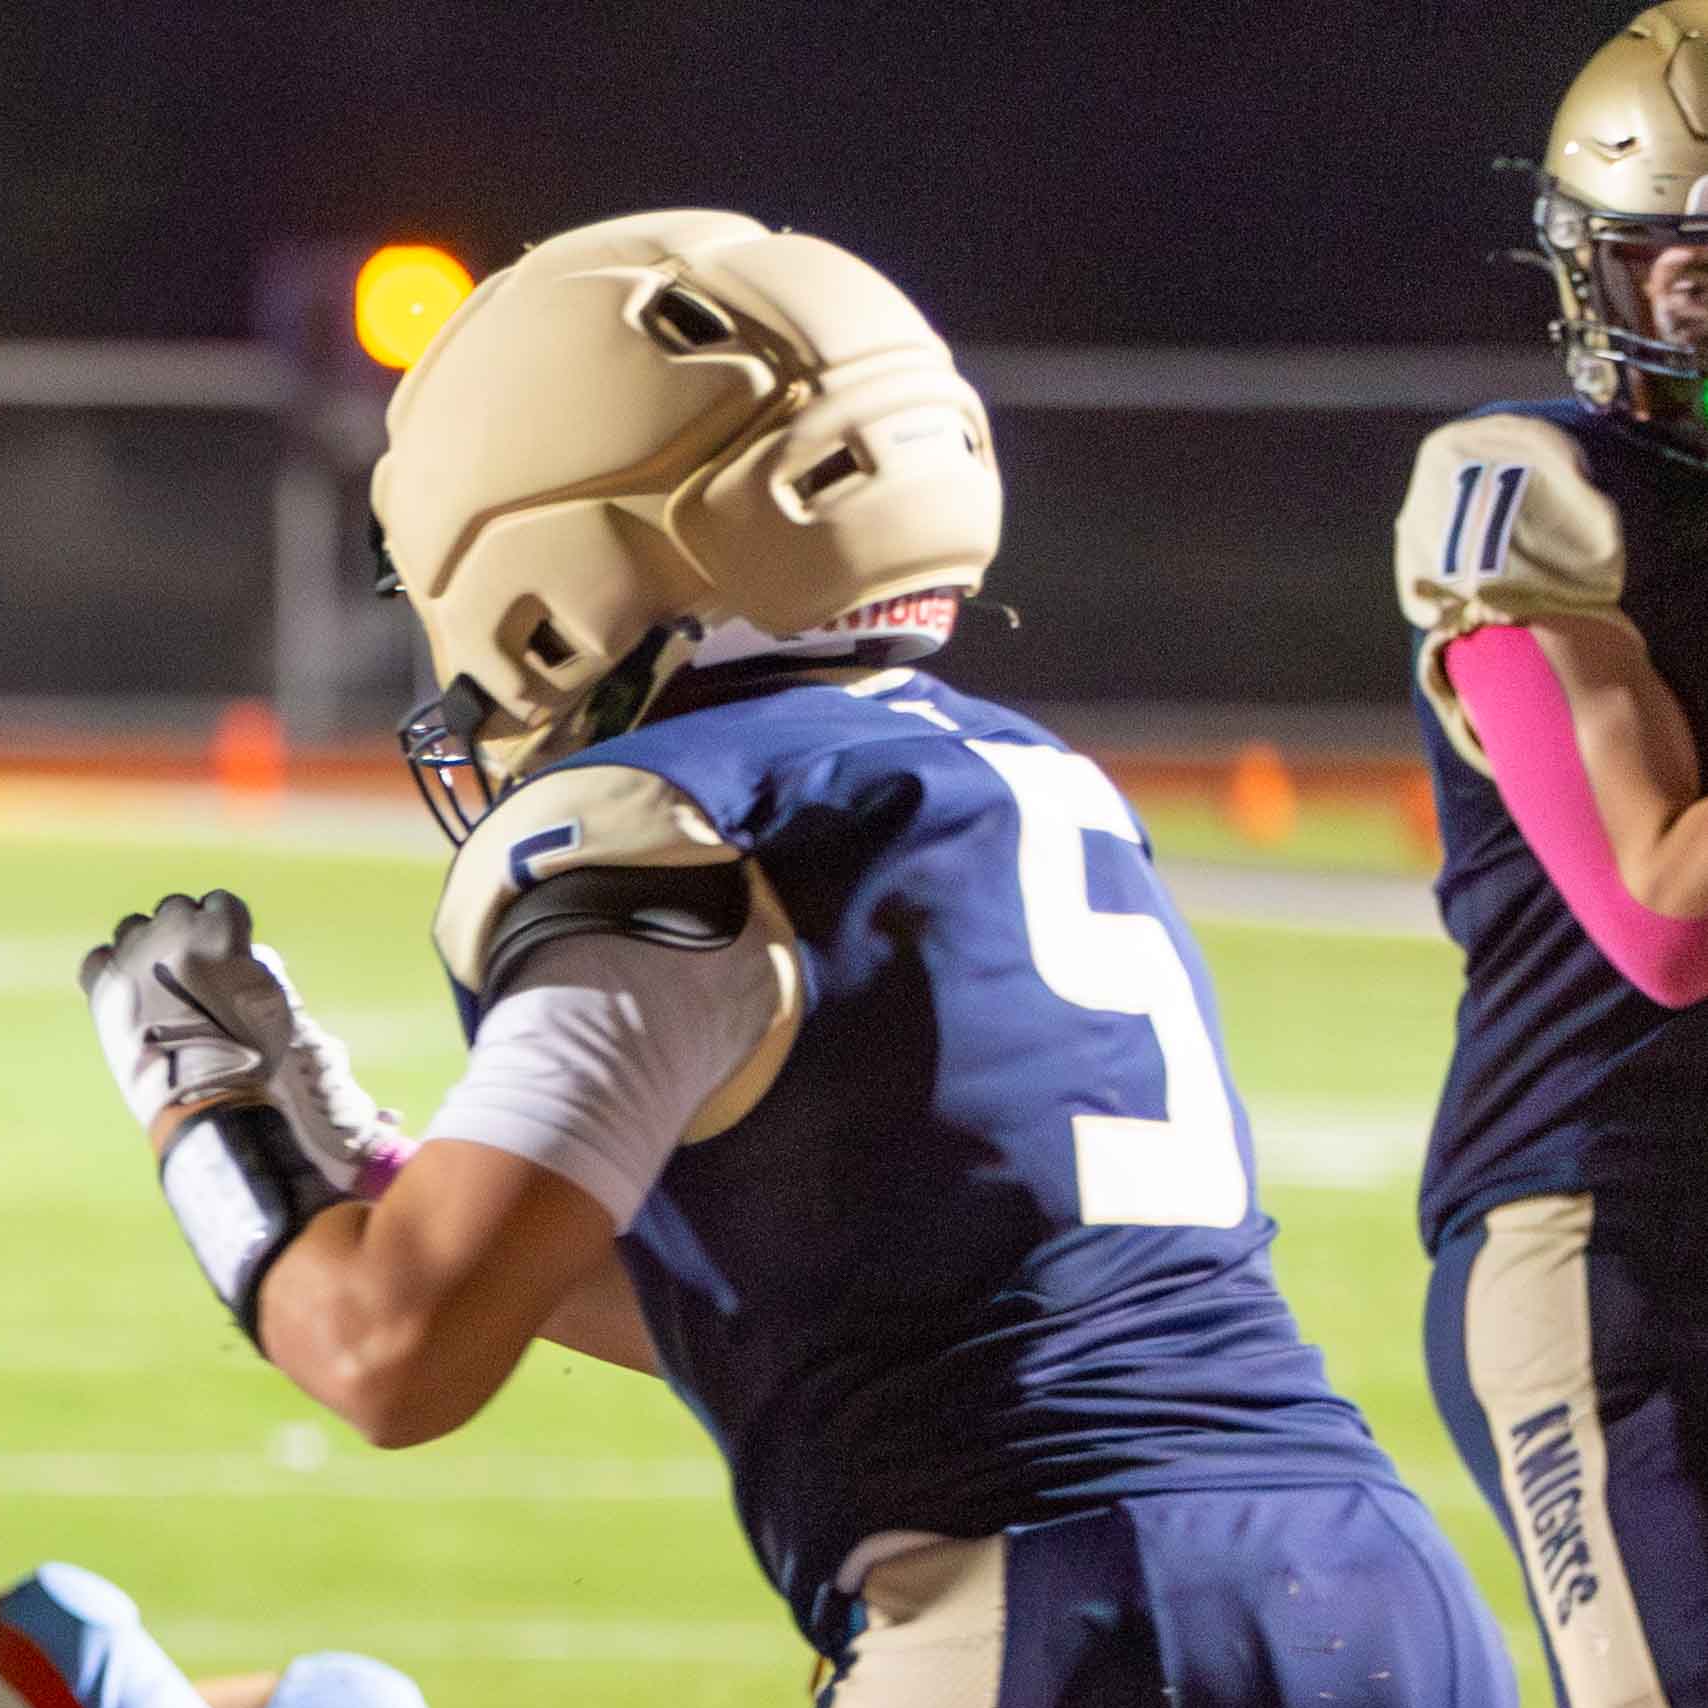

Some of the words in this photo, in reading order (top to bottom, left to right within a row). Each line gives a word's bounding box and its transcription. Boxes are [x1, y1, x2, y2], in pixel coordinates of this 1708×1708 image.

[1441, 459, 1533, 578] 11
[964, 737, 1248, 1228] 5
[1509, 1402, 1600, 1630] KNIGHTS
